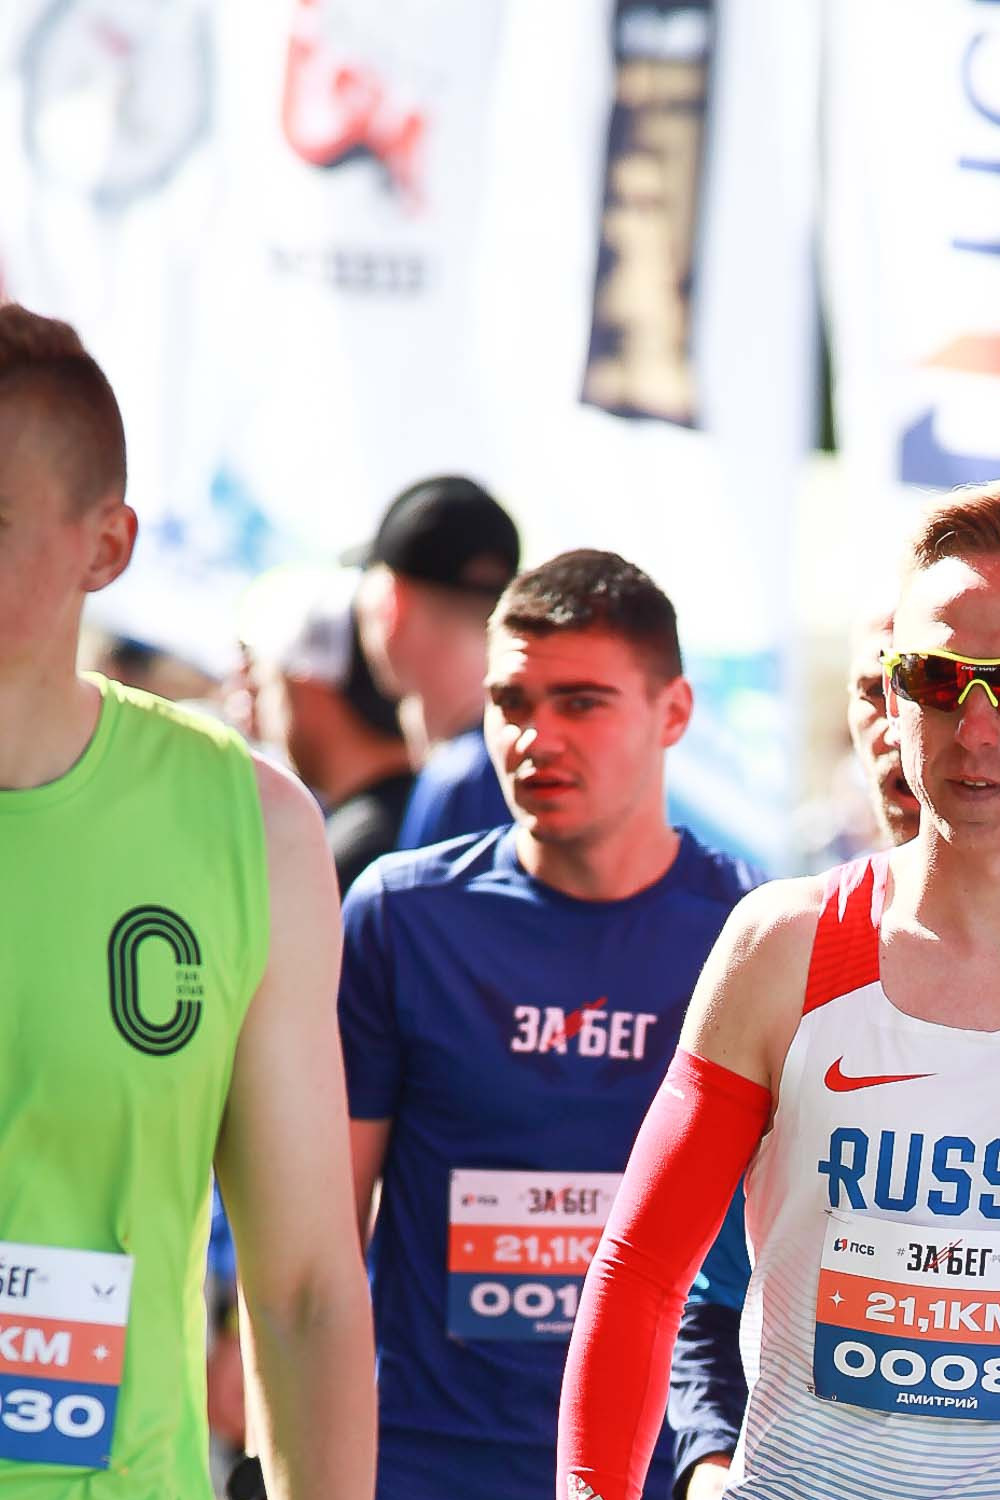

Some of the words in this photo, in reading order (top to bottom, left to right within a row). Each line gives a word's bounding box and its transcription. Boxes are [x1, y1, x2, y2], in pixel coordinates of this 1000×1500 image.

[494, 1234, 600, 1268] 21,1К
[850, 1242, 875, 1256] ПСБ
[469, 1281, 579, 1318] 001
[0, 1388, 106, 1438] 30
[896, 1392, 979, 1409] ДМИТРИЙ
